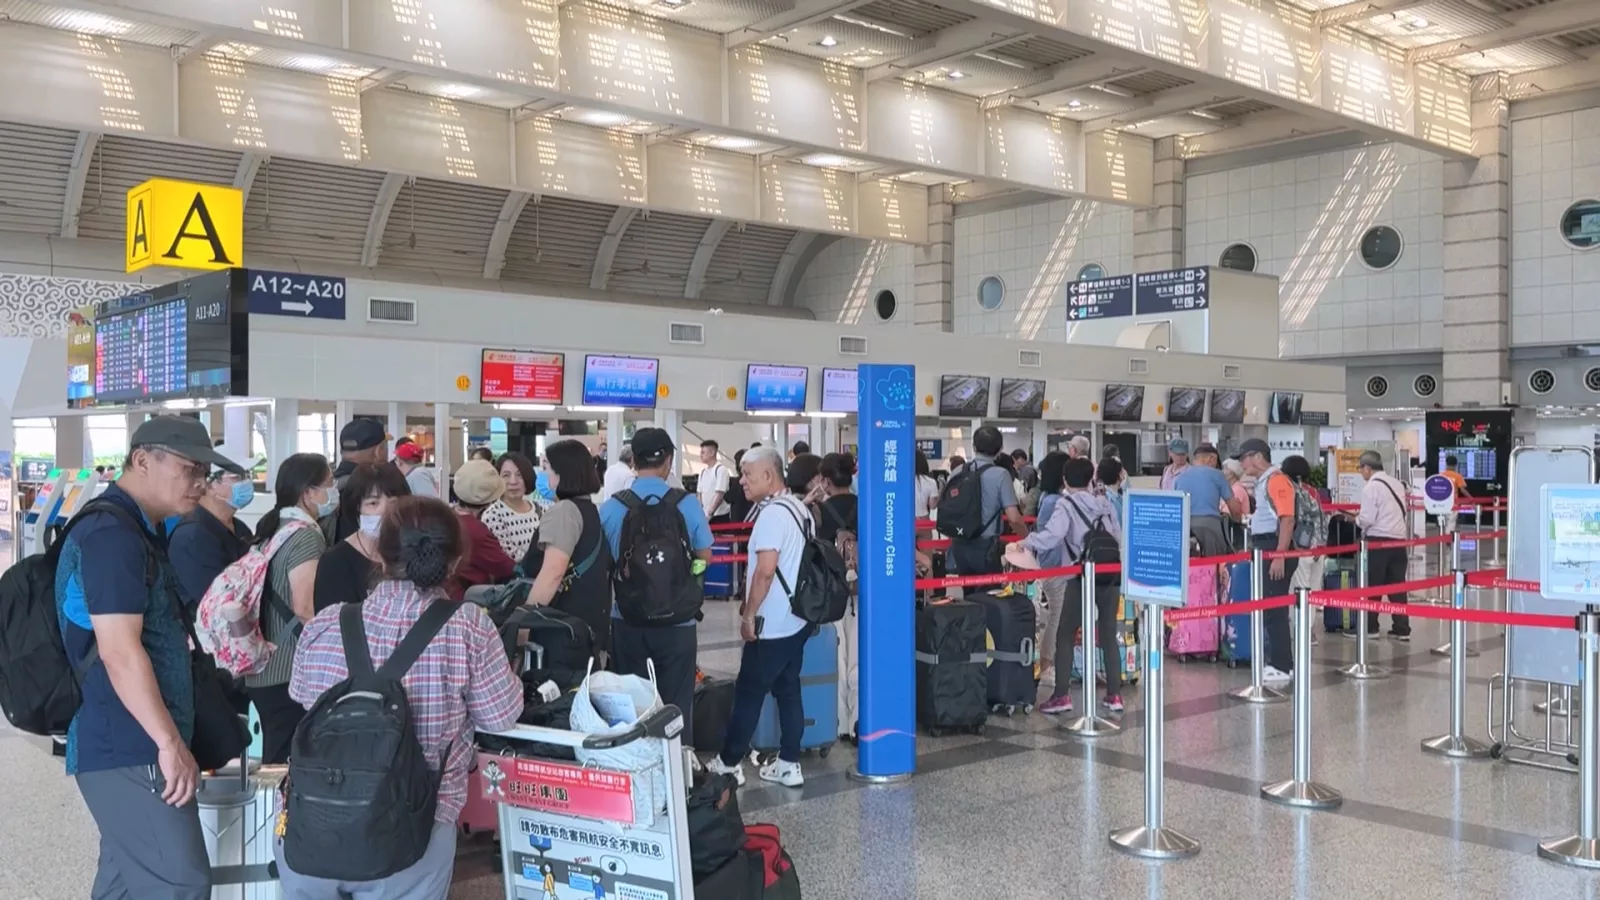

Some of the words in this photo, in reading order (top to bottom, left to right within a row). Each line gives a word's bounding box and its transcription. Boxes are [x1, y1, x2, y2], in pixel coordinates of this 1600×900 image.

[132, 198, 148, 258] A
[161, 191, 235, 265] A
[252, 275, 344, 299] A12~A20
[196, 302, 220, 320] A11-A20
[884, 439, 897, 482] 經濟艙
[884, 491, 896, 543] Economy
[886, 545, 896, 577] Class
[1329, 597, 1376, 609] International
[1379, 603, 1407, 614] Airport
